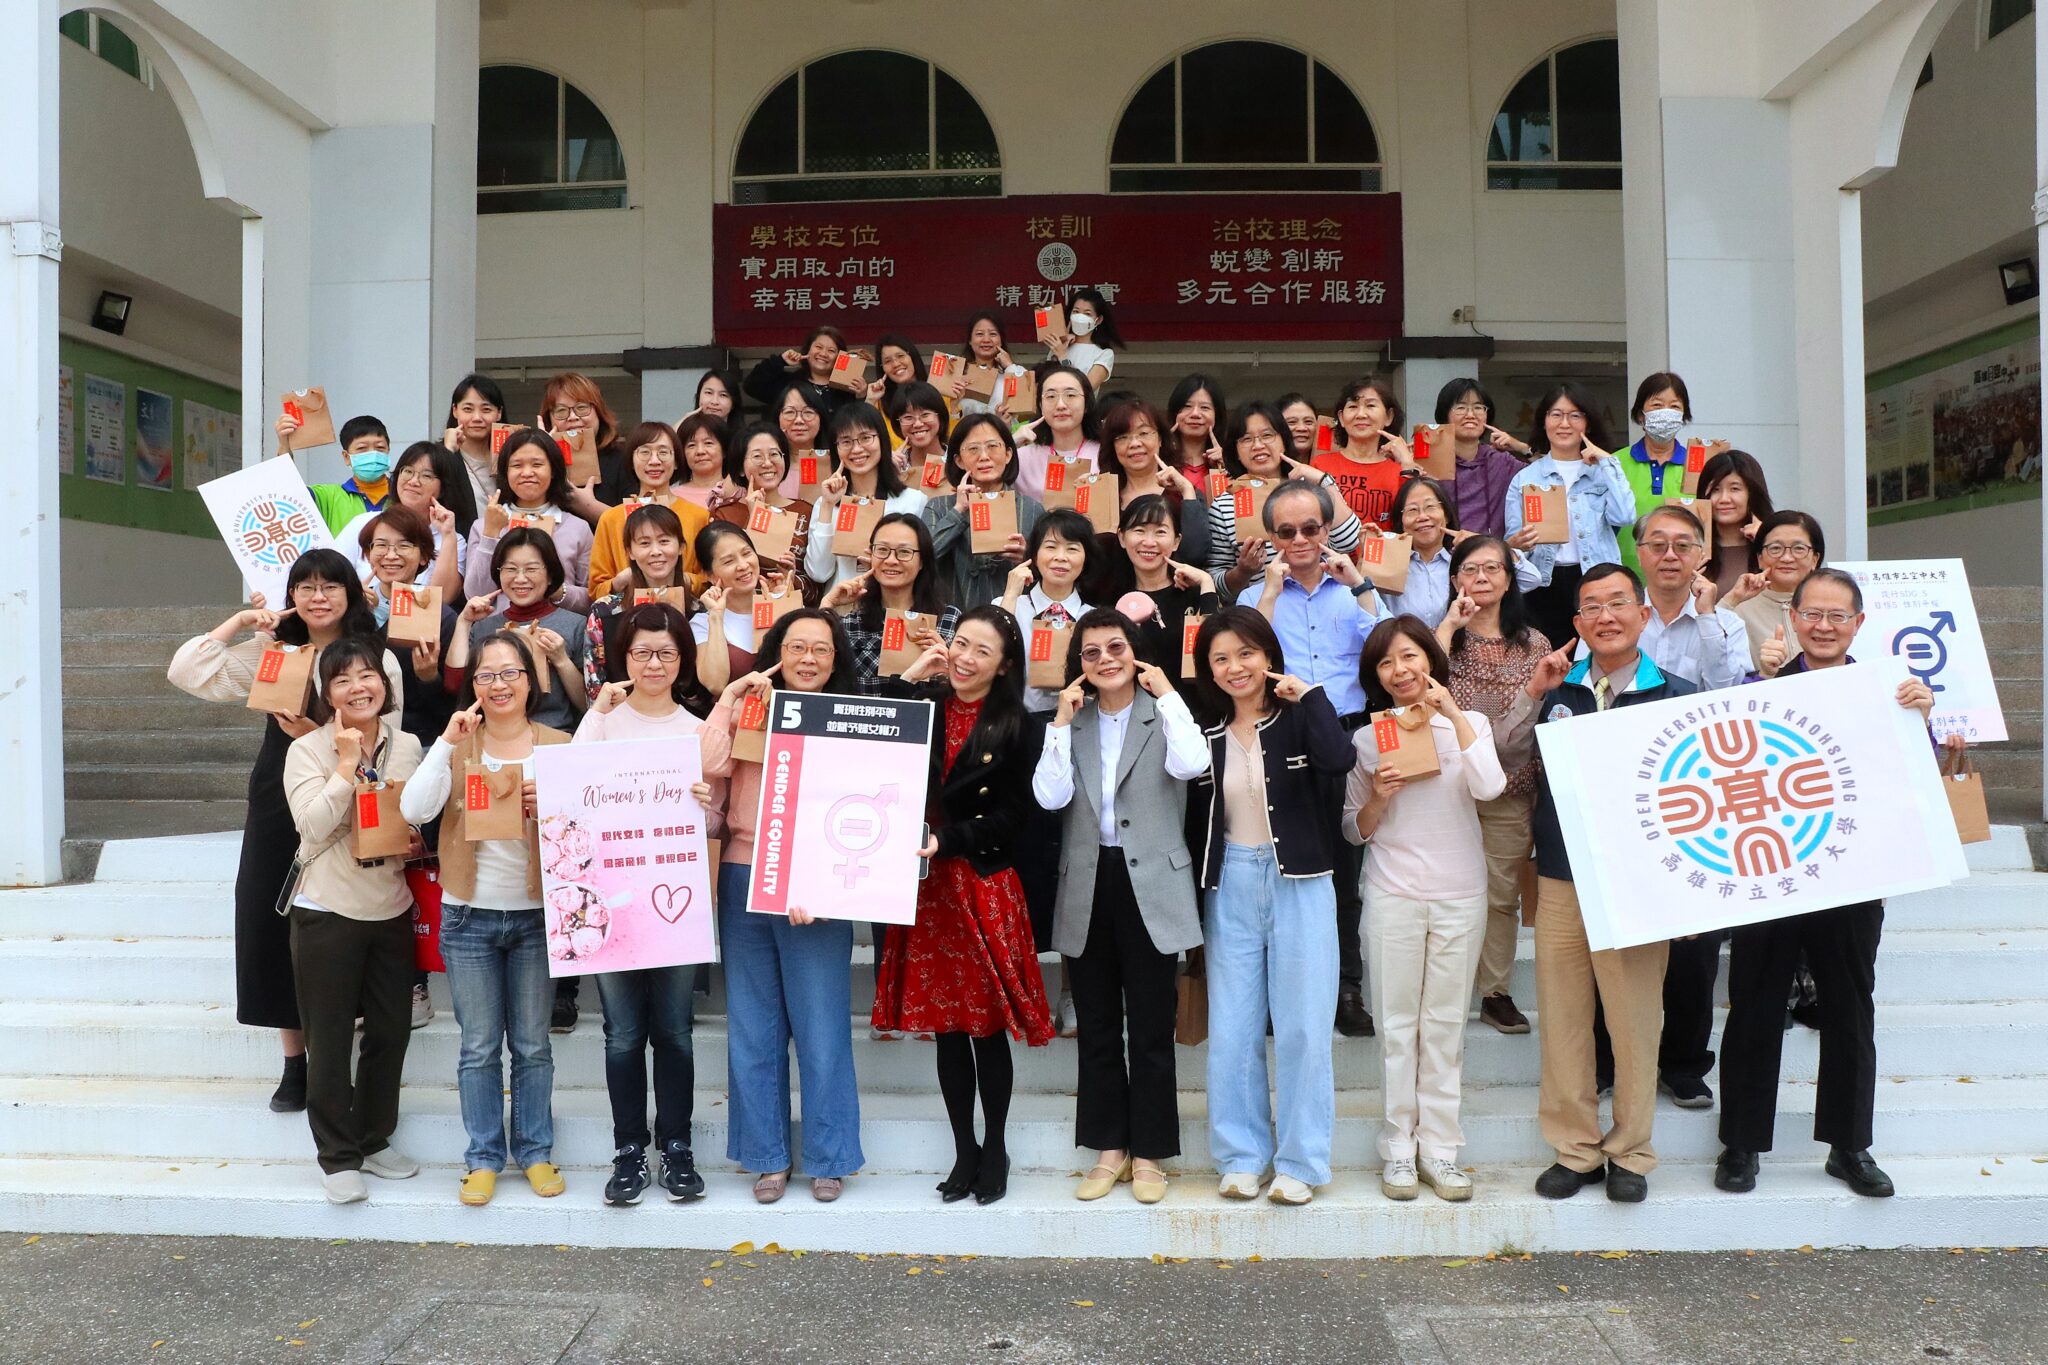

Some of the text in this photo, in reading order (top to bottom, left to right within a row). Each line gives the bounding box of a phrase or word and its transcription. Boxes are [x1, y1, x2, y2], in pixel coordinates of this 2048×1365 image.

[750, 224, 881, 249] 學校定位
[1025, 214, 1092, 240] 校訓
[1212, 217, 1343, 242] 治校理念
[739, 256, 895, 280] 實用取向的
[1210, 248, 1344, 273] 蛻變創新
[750, 285, 881, 311] 幸福大學
[1177, 278, 1386, 305] 多元合作服務
[1333, 474, 1367, 488] OVE
[781, 700, 802, 729] 5
[833, 703, 897, 718] 實現性別平等
[614, 769, 682, 778] INTERNATIONAL
[1635, 699, 1858, 841] OPEN UNIVERSITY OF KAOHSIUNG
[653, 781, 685, 804] Day
[602, 829, 644, 841] 現代女性
[762, 750, 791, 895] GENDER EQUALITY
[655, 852, 697, 864] 重視自己
[1660, 816, 1858, 900] 高雄市立空中大學
